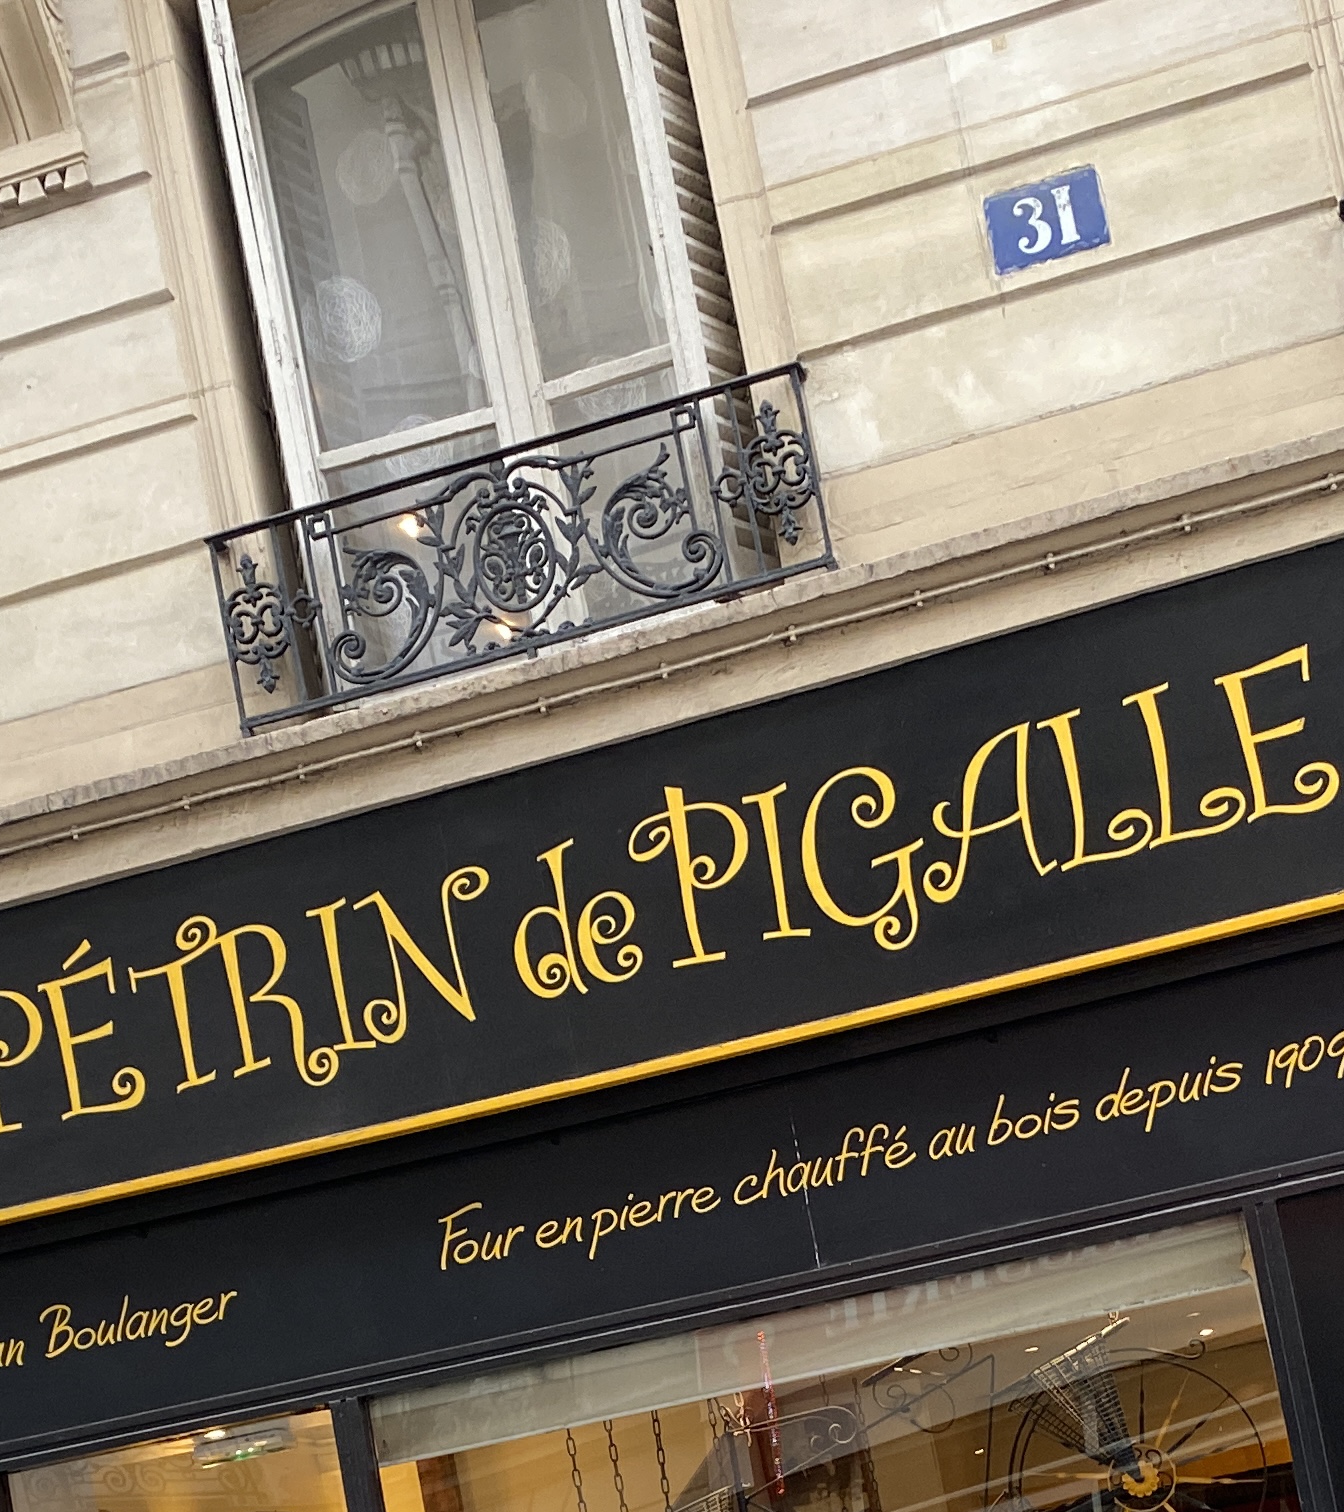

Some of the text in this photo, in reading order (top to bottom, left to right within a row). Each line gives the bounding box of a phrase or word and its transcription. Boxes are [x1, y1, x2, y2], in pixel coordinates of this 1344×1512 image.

[1012, 185, 1081, 254] 31
[513, 838, 644, 999] de
[628, 643, 1340, 968] PIGALLE
[440, 1202, 525, 1270] Four
[535, 1216, 583, 1249] en
[587, 1187, 720, 1260] pierre
[733, 1124, 917, 1206] chauffé
[929, 1125, 976, 1160] au
[987, 1094, 1080, 1146] bois
[1095, 1056, 1243, 1133] depuis
[39, 1290, 238, 1360] Boulanger
